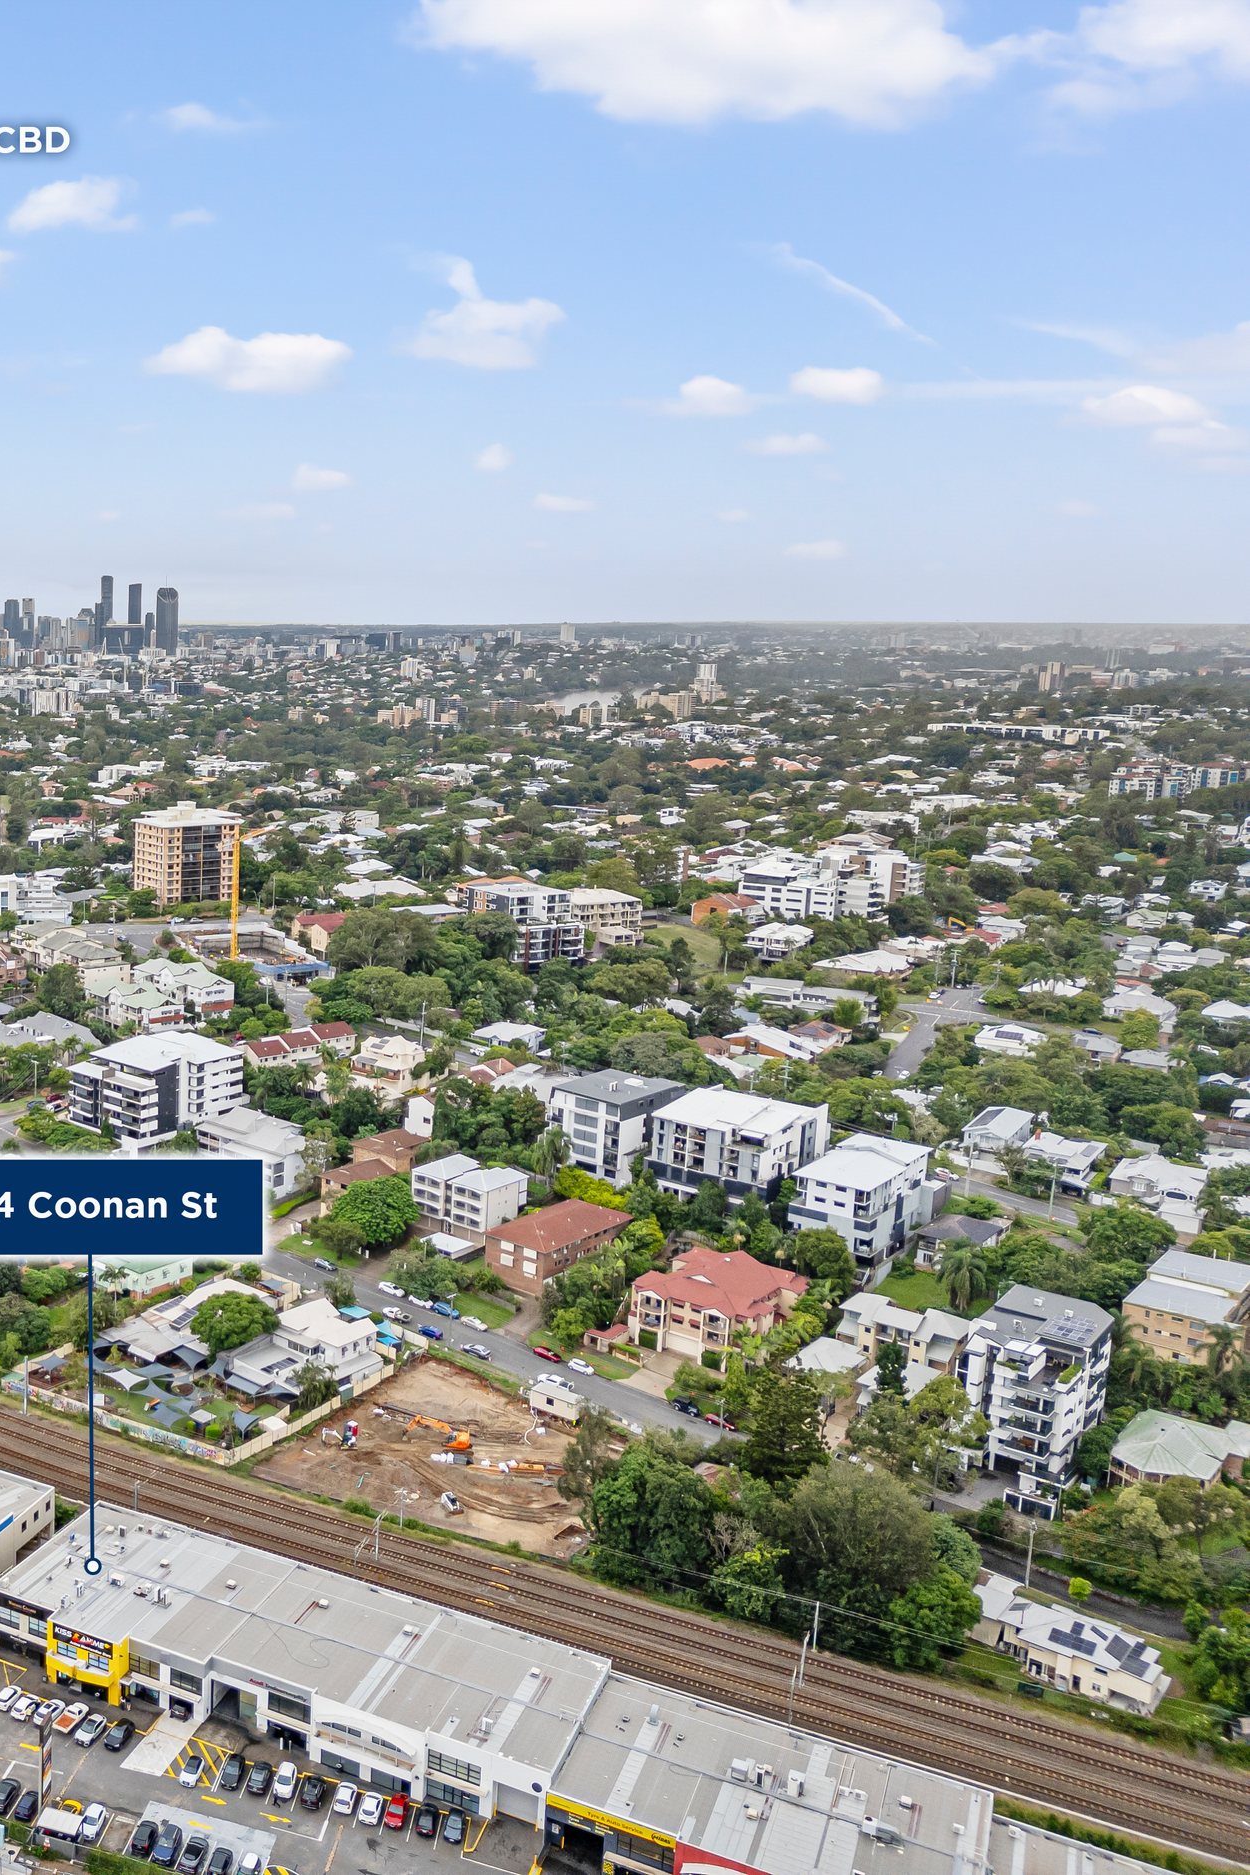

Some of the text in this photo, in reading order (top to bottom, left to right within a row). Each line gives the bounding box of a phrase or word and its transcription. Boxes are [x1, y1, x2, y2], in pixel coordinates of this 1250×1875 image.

[54, 1626, 72, 1638] KISS
[587, 1811, 599, 1820] Tyre
[606, 1819, 620, 1828] Auto
[621, 1823, 644, 1835] Service
